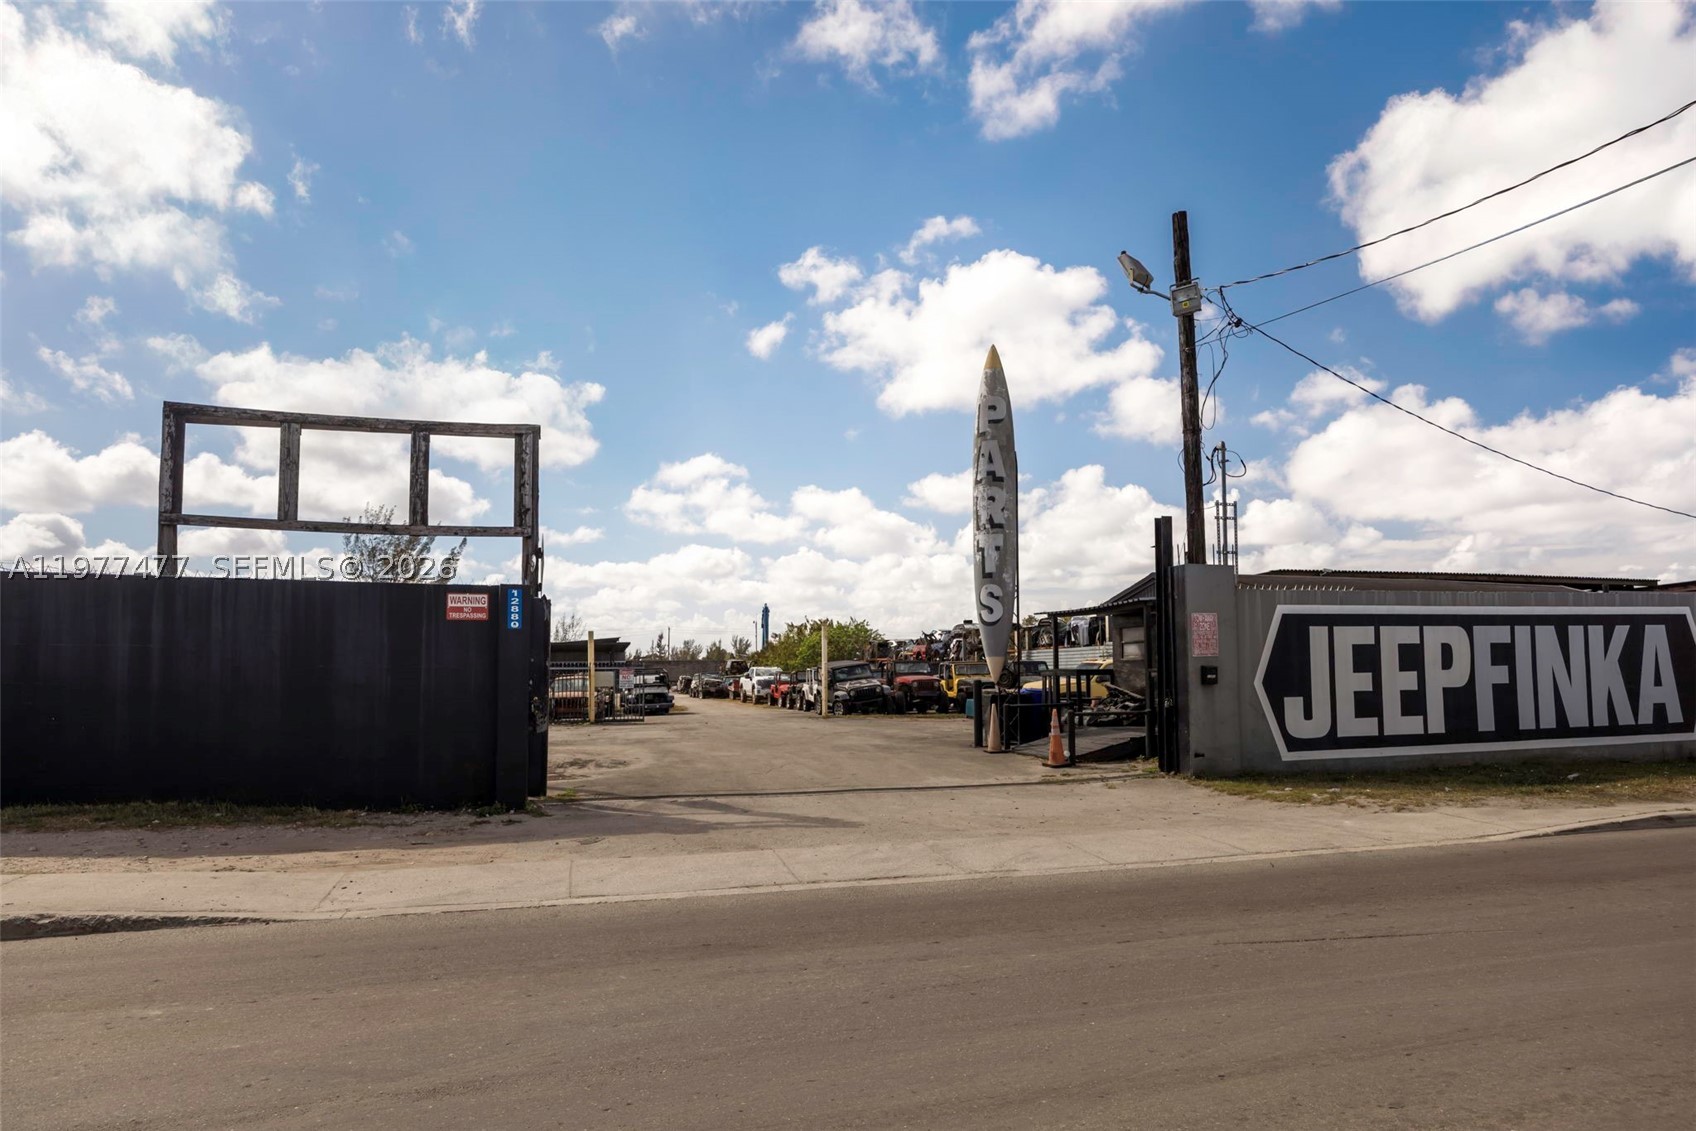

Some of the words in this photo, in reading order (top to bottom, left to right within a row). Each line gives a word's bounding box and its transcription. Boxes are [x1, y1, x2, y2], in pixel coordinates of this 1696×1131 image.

[974, 396, 1006, 626] PARTS
[449, 596, 487, 605] WARNING
[510, 589, 519, 629] 12880
[1284, 624, 1684, 739] JEEPFINKA
